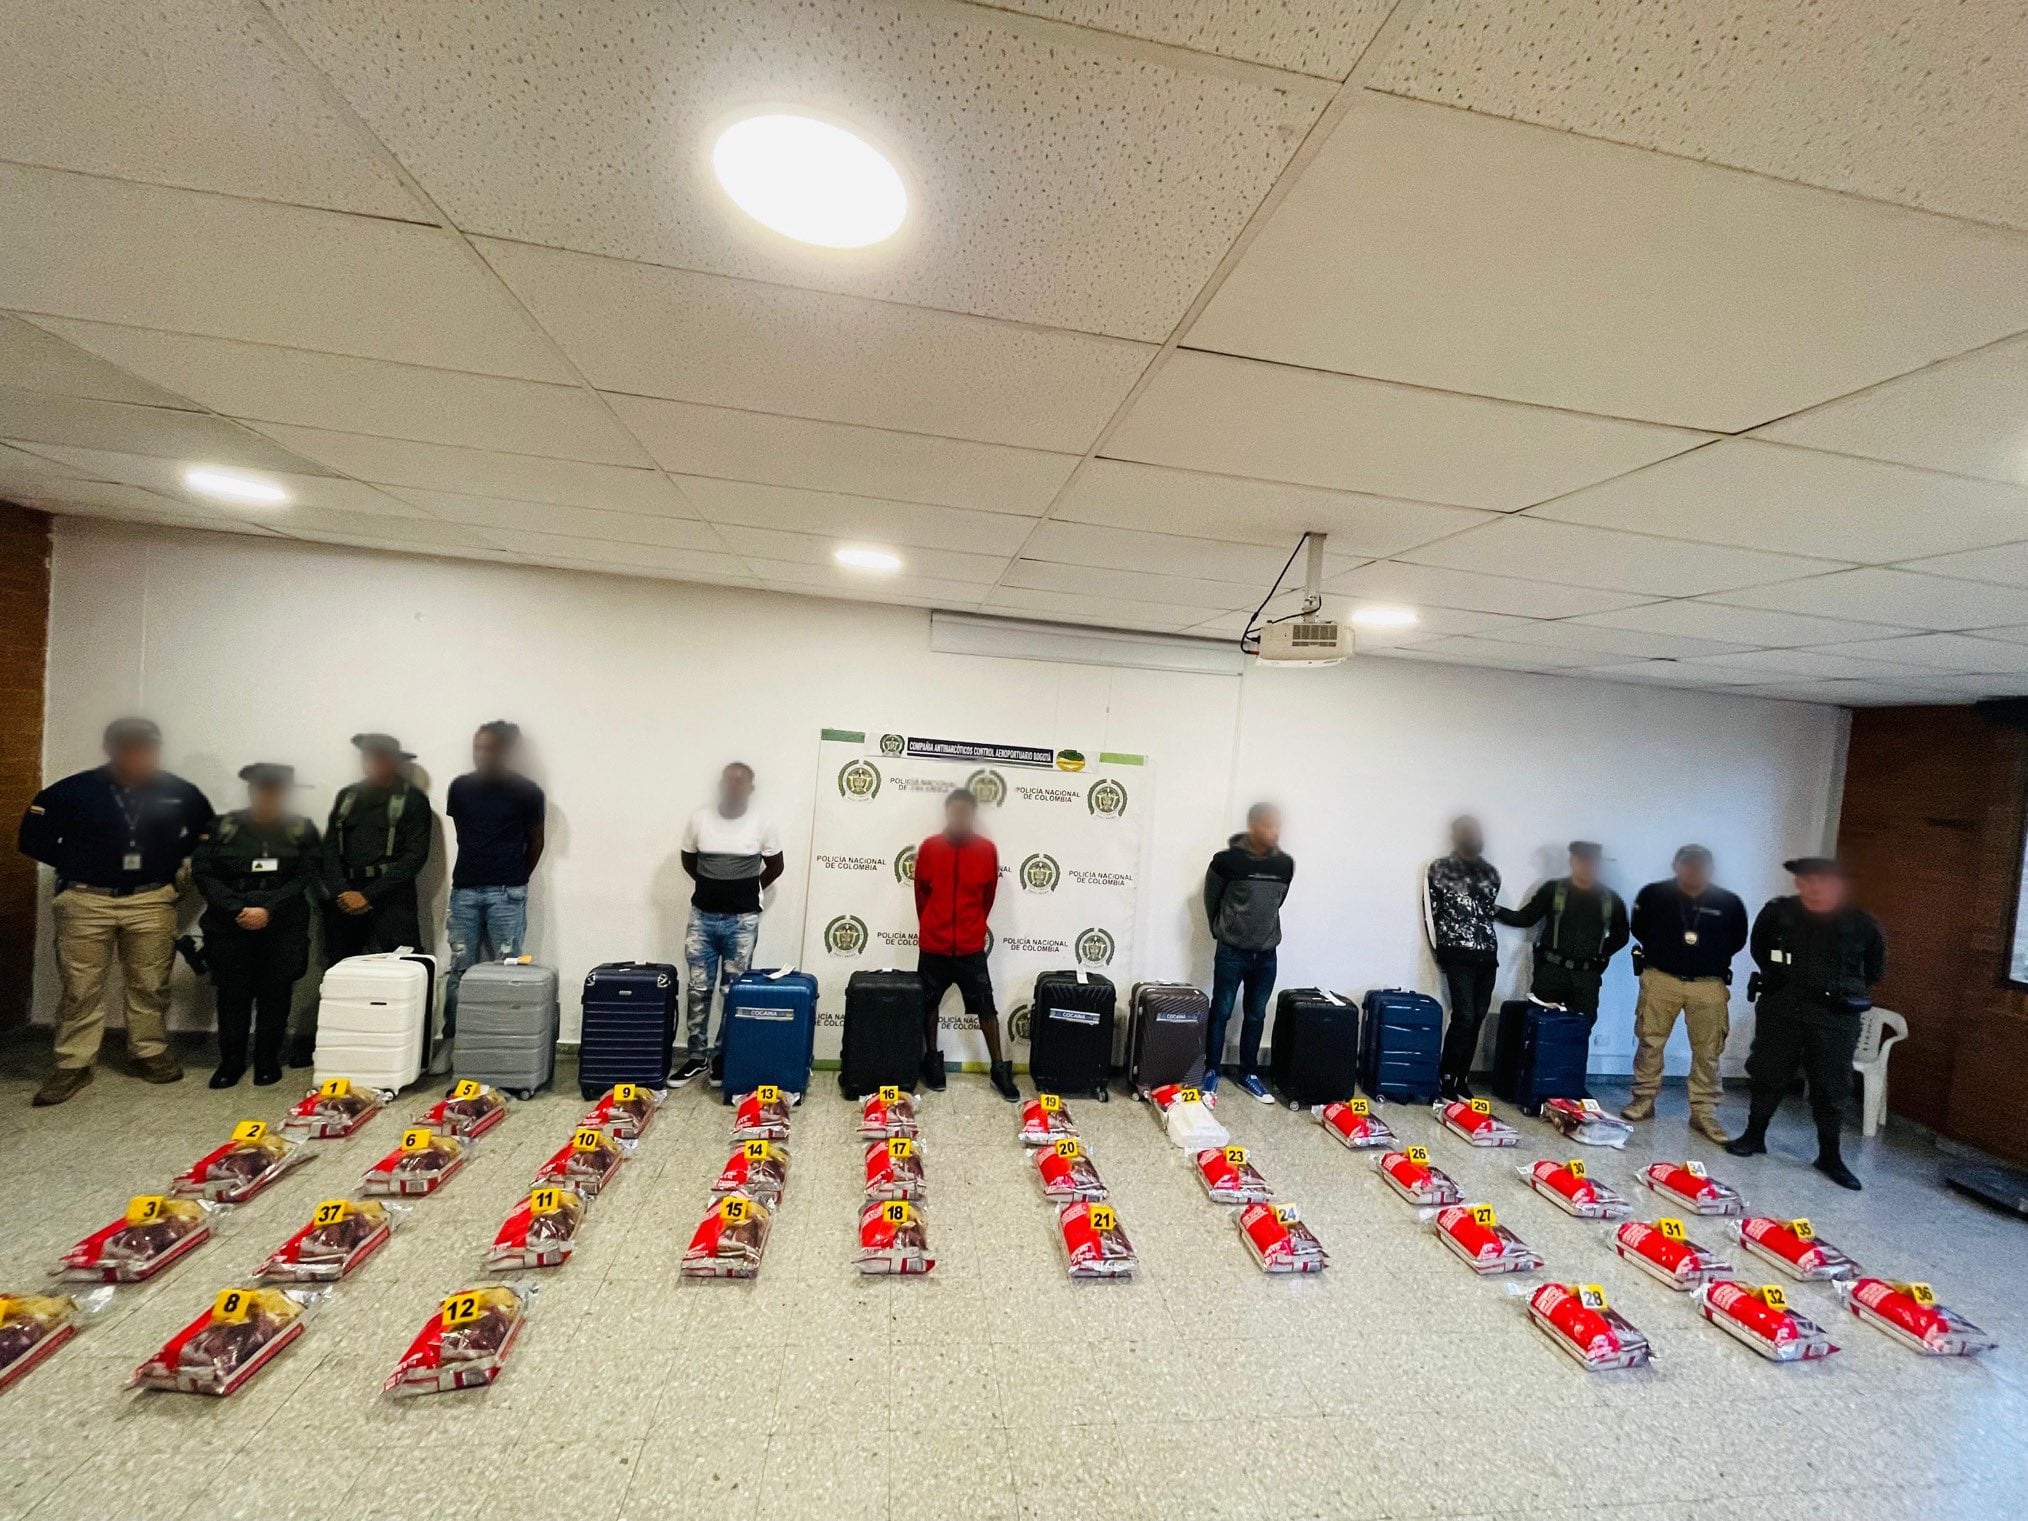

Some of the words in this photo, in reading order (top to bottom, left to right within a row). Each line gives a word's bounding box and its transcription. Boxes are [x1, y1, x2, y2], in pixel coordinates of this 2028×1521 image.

[973, 747, 995, 757] CONTROL
[996, 749, 1033, 760] AEROPORTUARIO
[1034, 794, 1072, 803] COLOMBIA
[1044, 789, 1081, 798] NACIONAL
[837, 862, 878, 871] COLOMBIA
[848, 857, 886, 865] NACIONAL
[1097, 872, 1133, 881] NACIONAL
[1076, 877, 1086, 885] DE
[1088, 878, 1125, 888] COLOMBIA
[1022, 944, 1060, 953] COLOMBIA
[1032, 939, 1069, 948] NACIONAL
[941, 1022, 951, 1030] DE
[329, 1083, 337, 1093] 1
[463, 1084, 472, 1095] 5
[623, 1088, 630, 1098] 9
[761, 1088, 773, 1099] 13
[883, 1089, 895, 1099] 16
[1182, 1092, 1196, 1102] 22
[1045, 1097, 1056, 1107] 19
[1354, 1102, 1366, 1112] 25
[1474, 1101, 1488, 1111] 29
[247, 1125, 260, 1137] 2
[406, 1134, 416, 1146] 6
[578, 1133, 594, 1146] 10
[748, 1144, 762, 1156] 14
[893, 1143, 906, 1154] 17
[1060, 1142, 1075, 1155] 20
[1412, 1148, 1426, 1159] 26
[1229, 1151, 1243, 1162] 23
[1573, 1163, 1584, 1174] 30
[536, 1192, 553, 1207] 11
[144, 1202, 156, 1217] 3
[319, 1205, 341, 1222] 37
[726, 1202, 742, 1216] 15
[888, 1206, 903, 1220] 18
[1278, 1208, 1296, 1221] 24
[1094, 1213, 1109, 1226] 21
[1477, 1209, 1491, 1222] 27
[1665, 1223, 1680, 1236] 31
[1797, 1223, 1811, 1235] 35
[1584, 1291, 1603, 1306] 28
[1768, 1289, 1785, 1304] 32
[1915, 1286, 1933, 1301] 36
[224, 1293, 240, 1312] 8
[447, 1298, 474, 1320] 12
